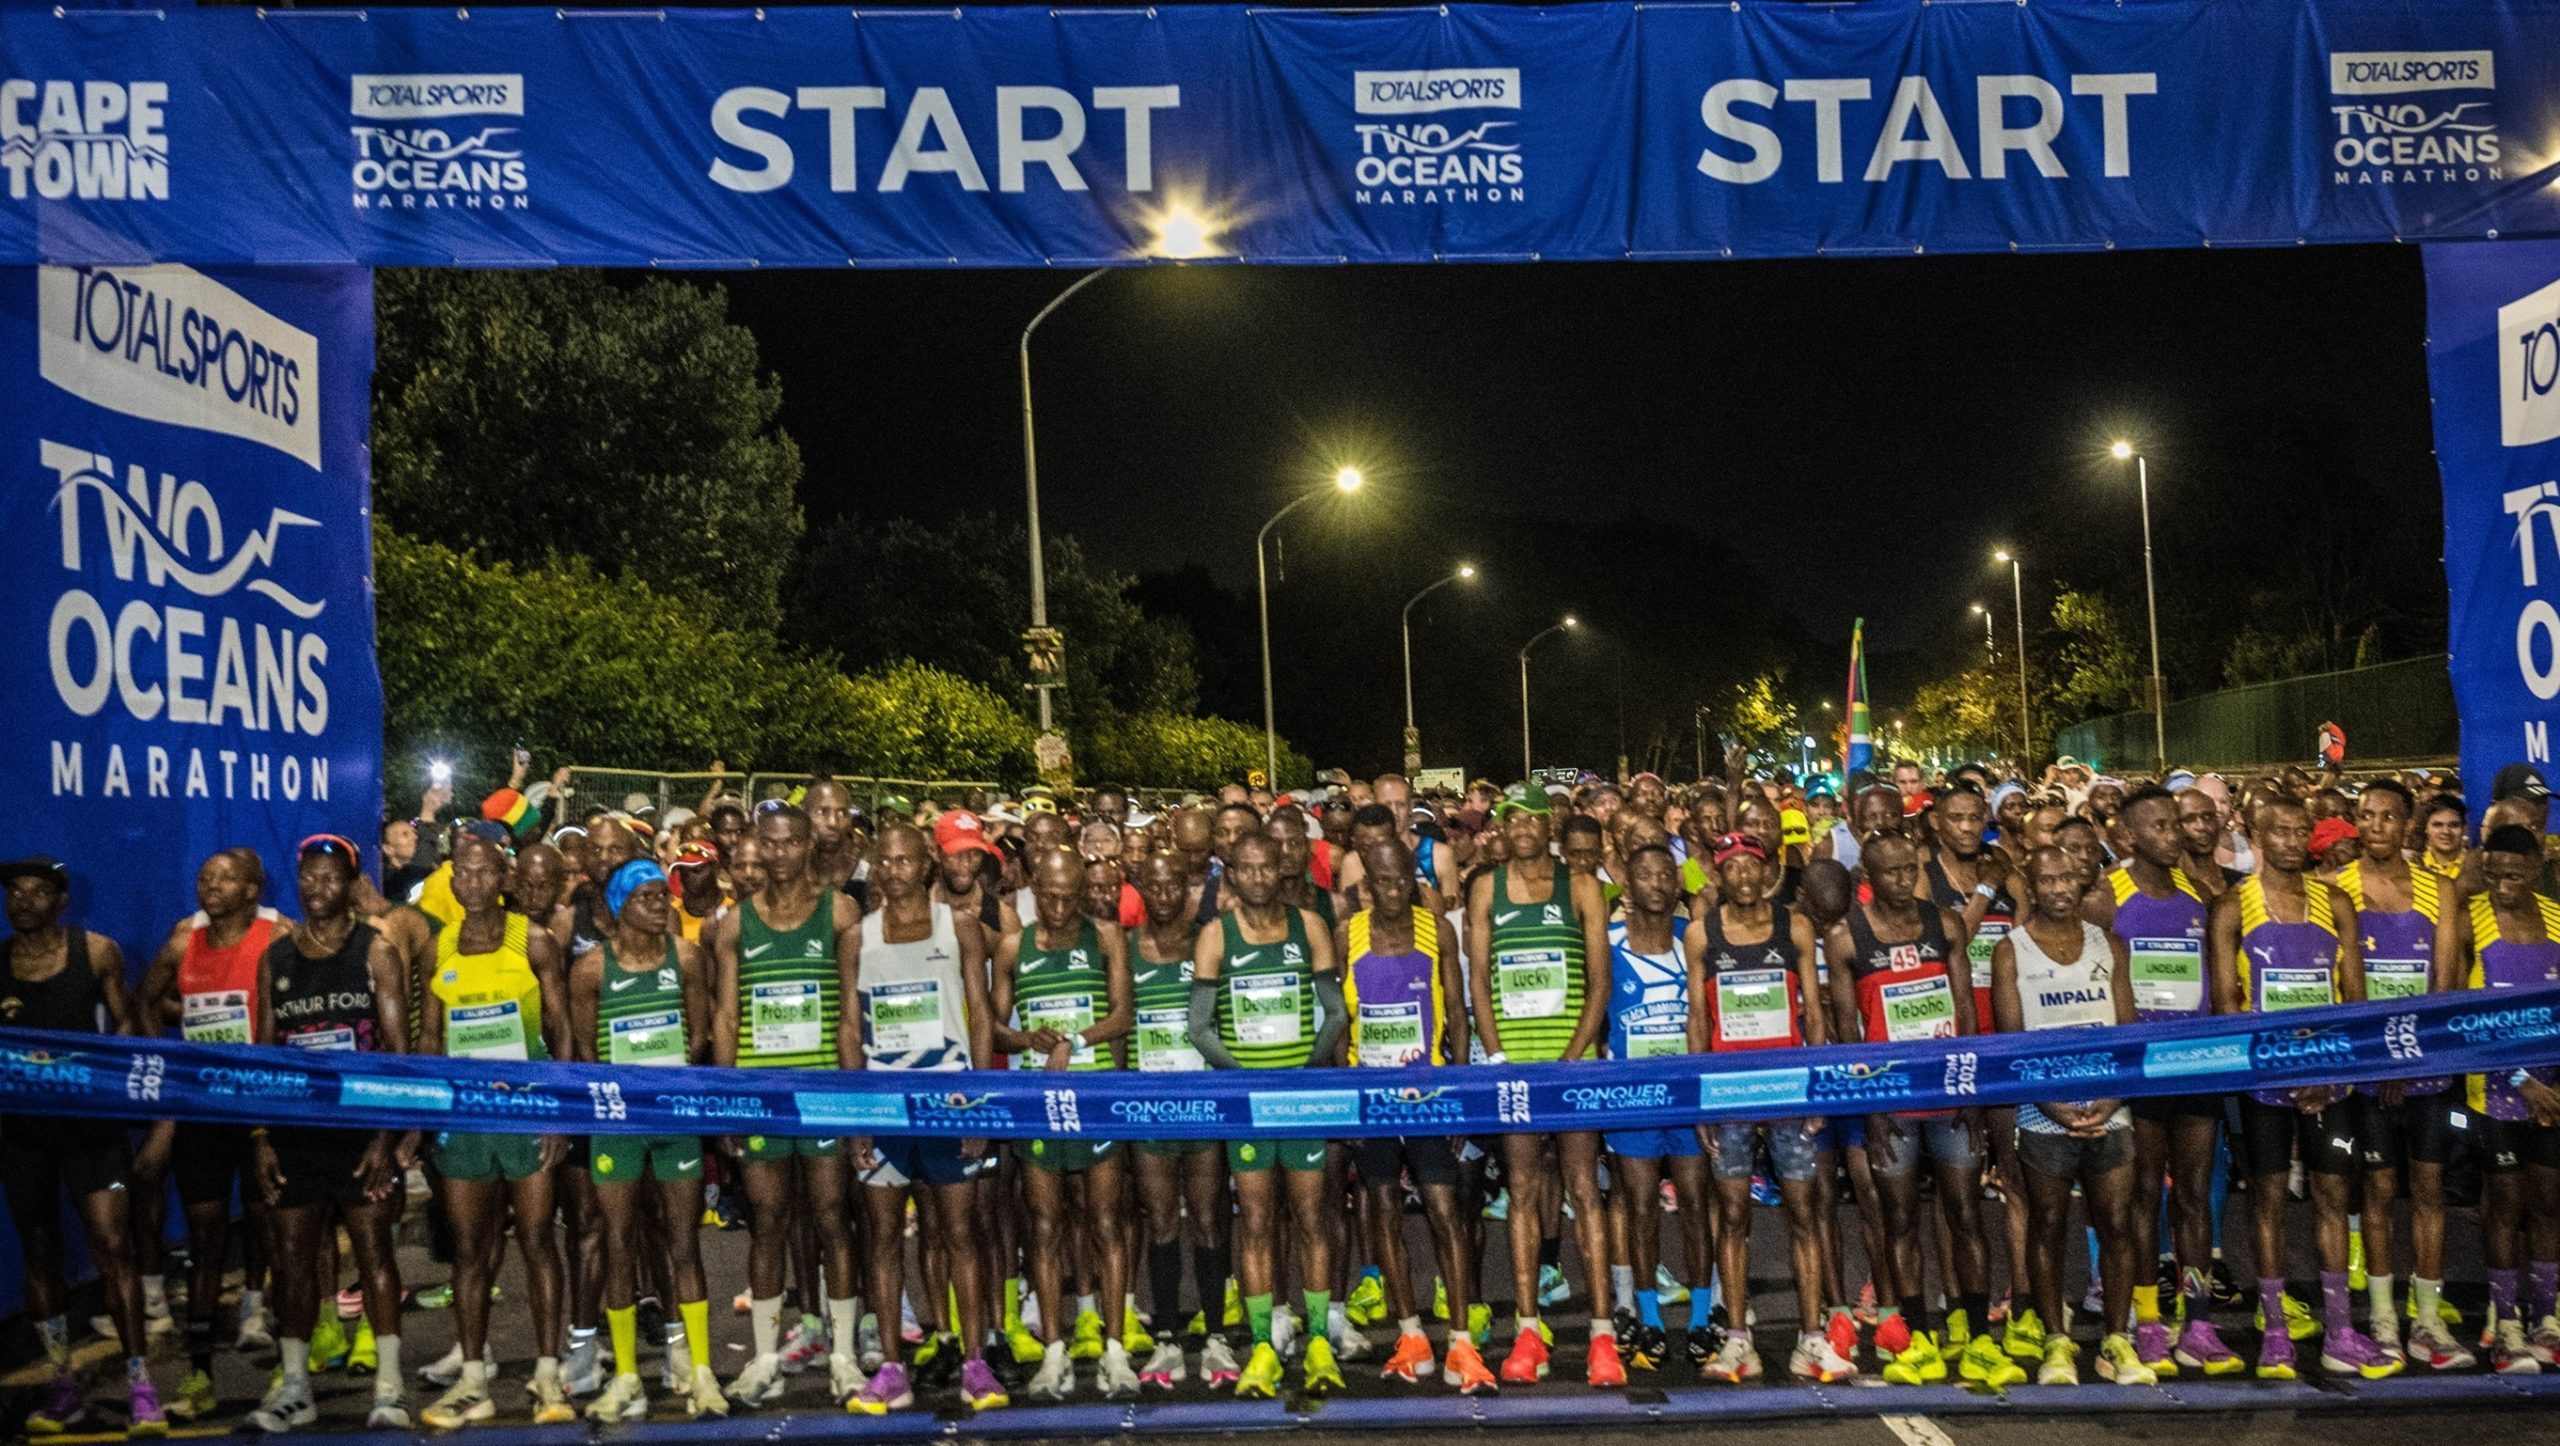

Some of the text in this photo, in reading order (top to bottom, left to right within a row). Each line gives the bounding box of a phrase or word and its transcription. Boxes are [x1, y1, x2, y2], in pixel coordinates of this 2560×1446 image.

[2346, 59, 2480, 83] TOTALSPORTS
[366, 82, 508, 107] TOTALSPORTS
[1369, 77, 1505, 103] TOTALSPORTS
[0, 78, 168, 137] CAPE
[2331, 104, 2427, 134] TWO
[708, 84, 1180, 193] START
[1355, 122, 1451, 154] TWO
[1697, 72, 2158, 185] START
[351, 126, 453, 160] TWO
[2334, 132, 2500, 167] OCEANS
[0, 140, 168, 199] TOWN
[352, 159, 528, 192] OCEANS
[1356, 154, 1523, 187] OCEANS
[2336, 168, 2503, 185] MARATHON
[353, 194, 529, 209] MARATHON
[1356, 188, 1524, 204] MARATHON
[73, 266, 300, 427] TOTALSPORTS
[40, 438, 224, 588] TWO
[48, 589, 328, 737] OCEANS
[51, 740, 329, 801] MARATHON
[1893, 946, 1919, 968] 45
[1969, 945, 1992, 957] ose
[1512, 967, 1551, 987] Lucky
[327, 992, 371, 1011] FORD
[1894, 996, 1945, 1019] Teboho
[2040, 988, 2107, 1007] IMPALA
[761, 1003, 812, 1022] Prosper
[1620, 1004, 1648, 1026] BLACK
[2447, 1006, 2552, 1033] CONQUER
[1362, 1023, 1416, 1042] Stephen
[2398, 1012, 2424, 1059] 2025
[2463, 1022, 2560, 1042] THE CURREN
[2255, 1036, 2352, 1059] OCEANS
[1957, 1051, 1979, 1095] 2025
[2009, 1051, 2114, 1071] CONQUER
[2020, 1062, 2119, 1082] THE CURRENT
[142, 1053, 166, 1102] 2025
[199, 1067, 309, 1088] CONQUER
[1814, 1073, 1912, 1092] OCEANS
[1944, 1053, 1960, 1096] #TTOM
[459, 1088, 560, 1108] OCEANS
[1496, 1081, 1511, 1123] #TTOM
[1510, 1079, 1531, 1124] 2025
[1562, 1083, 1669, 1104] CONQUER
[1607, 1095, 1674, 1108] CURRENT
[1057, 1088, 1082, 1133] 2025
[1110, 1099, 1218, 1116] CONQUER
[1157, 1112, 1228, 1123] CURRENT
[1366, 1101, 1464, 1117] OCEANS
